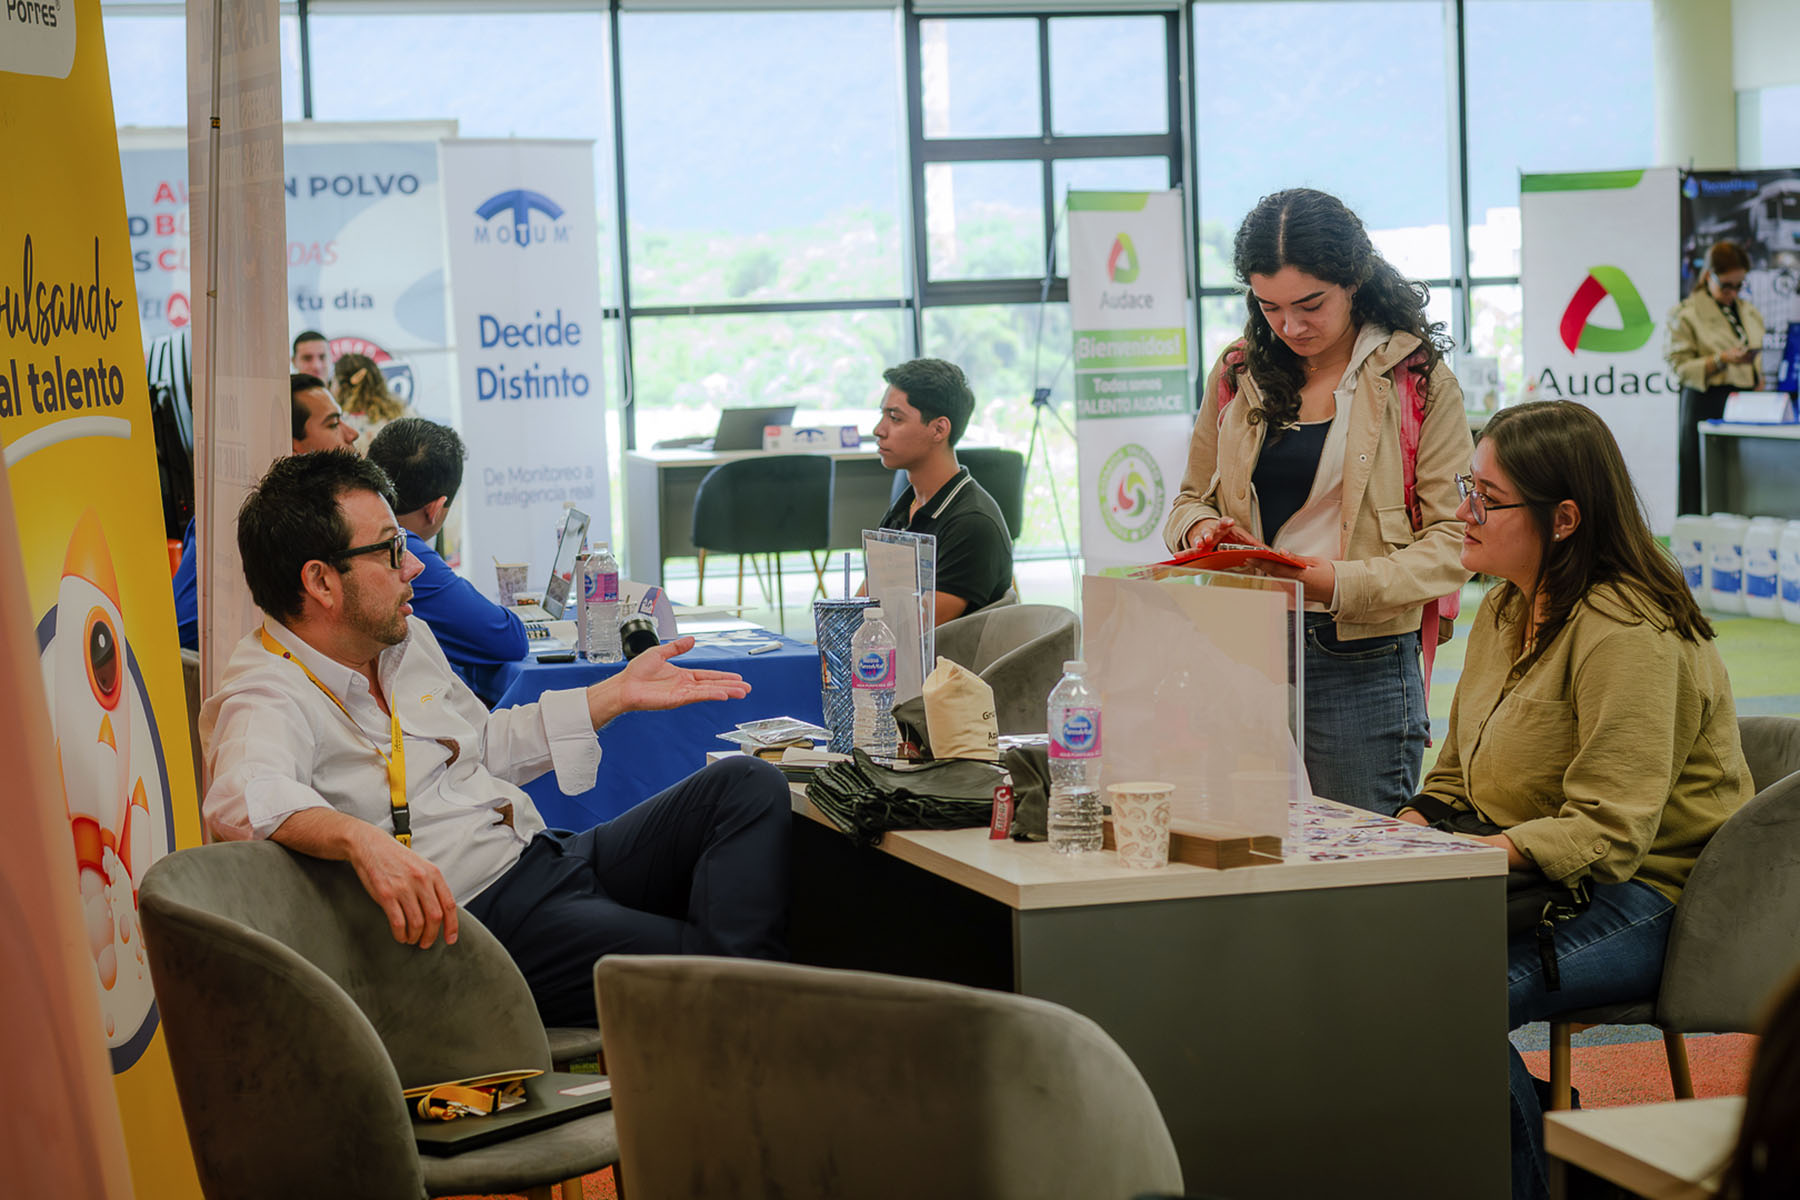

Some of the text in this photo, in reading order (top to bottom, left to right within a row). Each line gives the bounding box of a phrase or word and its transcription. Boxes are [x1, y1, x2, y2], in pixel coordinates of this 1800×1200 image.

[309, 174, 419, 197] POLVO
[474, 224, 570, 247] MOTUM
[0, 233, 122, 346] ulsando
[297, 289, 374, 311] tu día
[479, 309, 581, 348] Decide
[0, 355, 124, 418] al talento
[476, 363, 590, 401] Distinto
